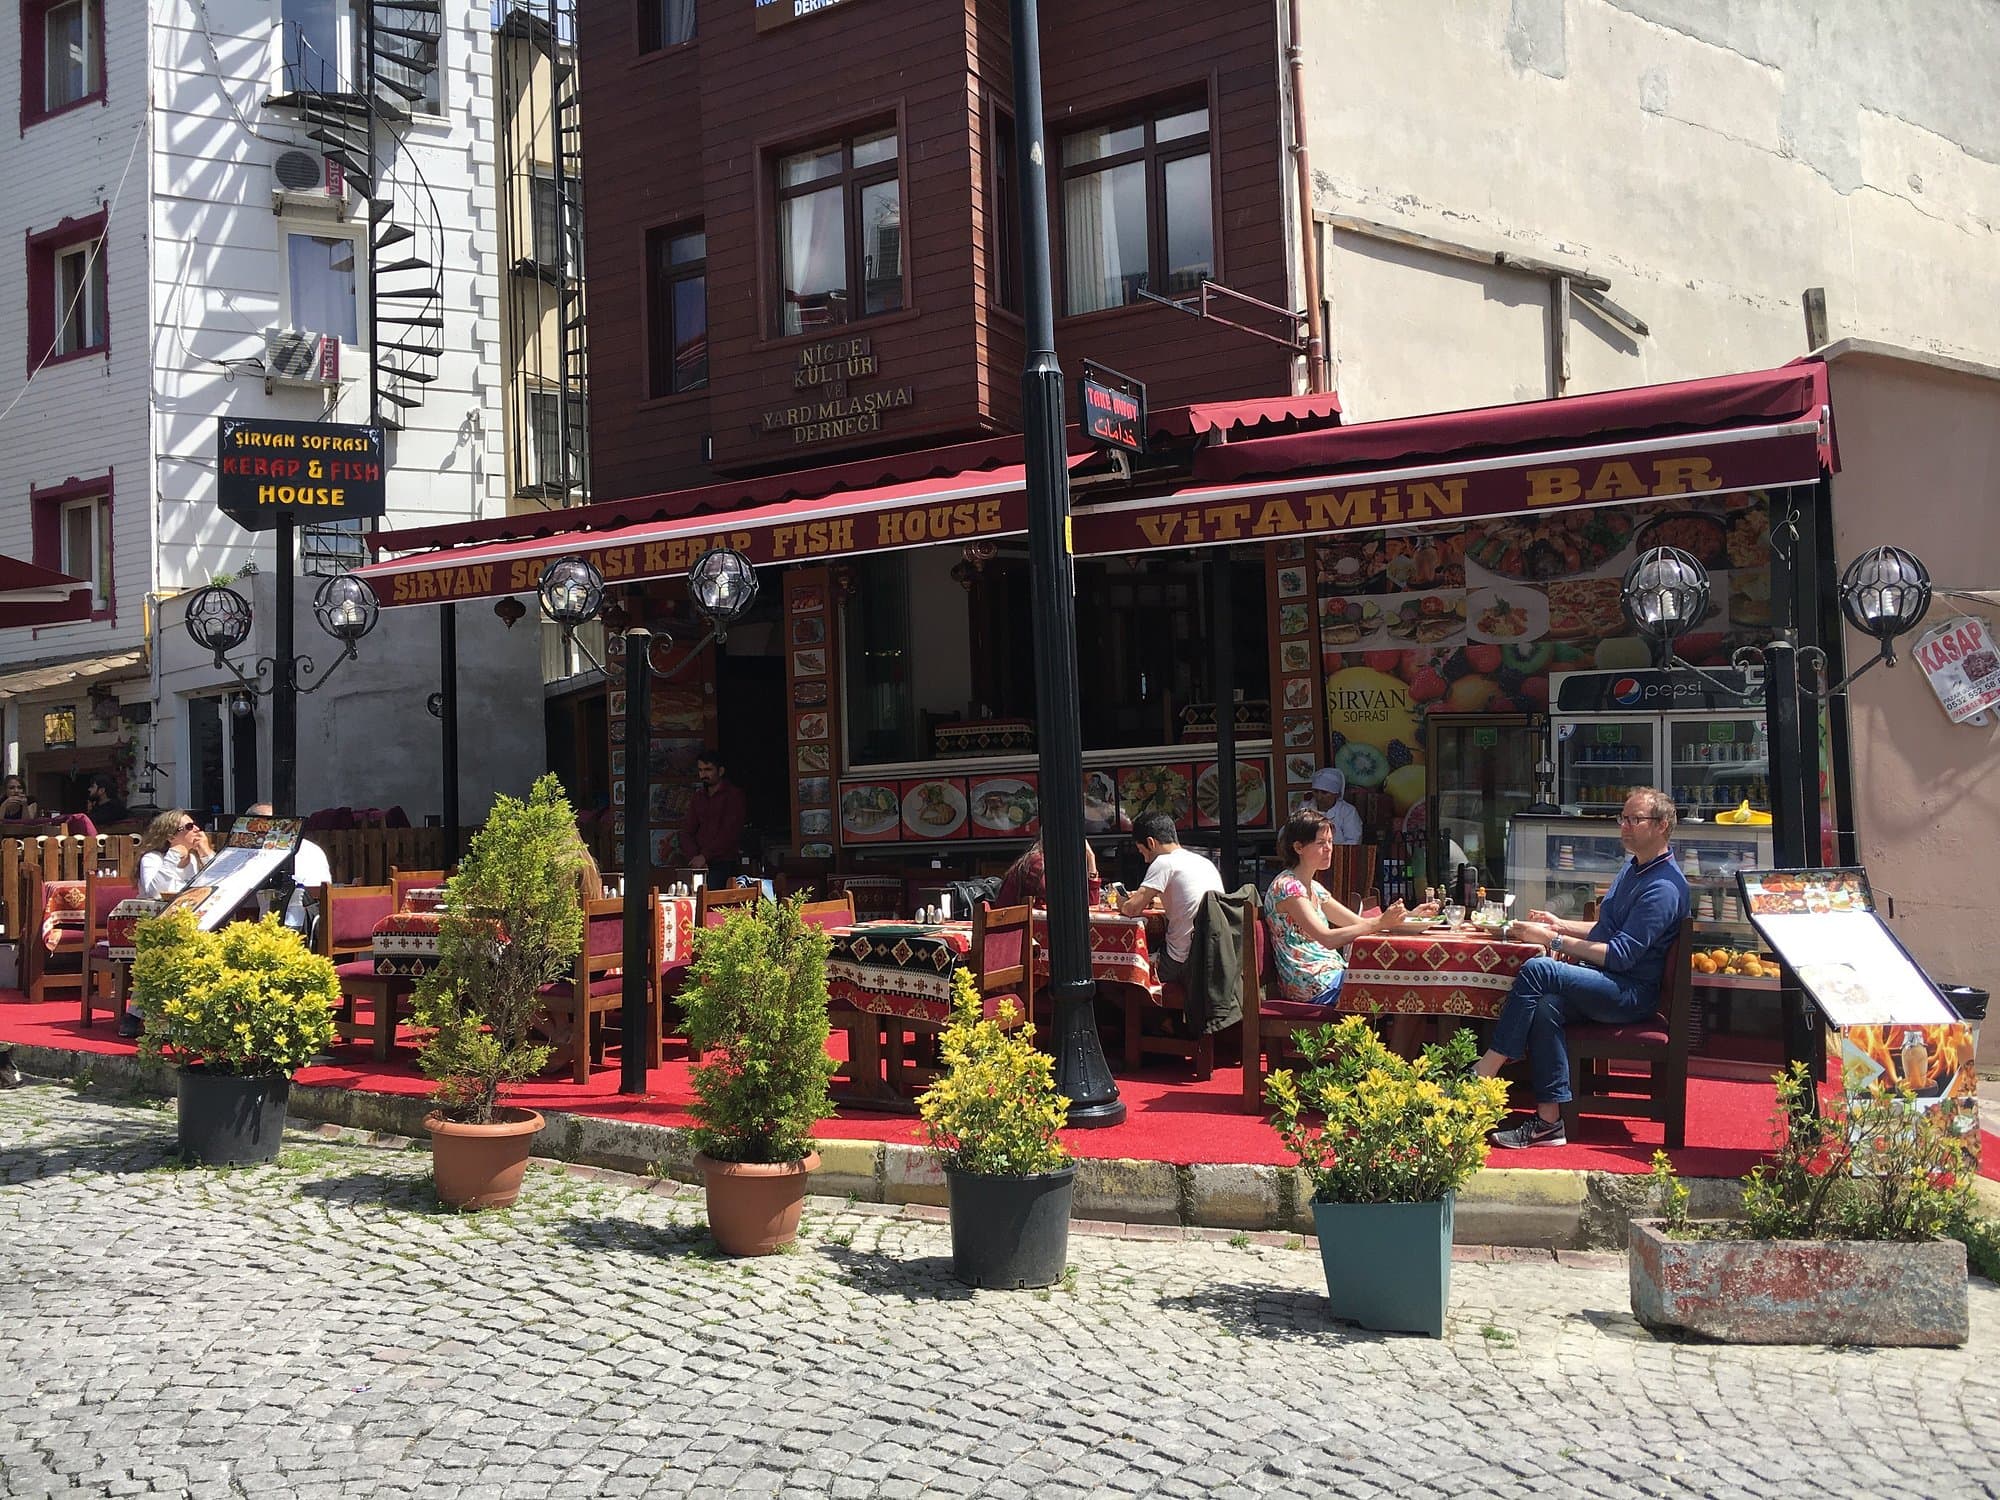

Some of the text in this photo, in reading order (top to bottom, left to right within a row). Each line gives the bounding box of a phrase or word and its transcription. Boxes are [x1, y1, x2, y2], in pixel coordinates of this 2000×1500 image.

[329, 160, 340, 194] VESTE
[324, 340, 334, 377] VESTEL
[1088, 387, 1137, 423] TAKE AWAY
[302, 435, 368, 452] SOFRASI
[223, 456, 379, 482] KEBAP & FISH
[1525, 456, 1724, 506] BAR
[258, 485, 345, 506] HOUSE
[511, 547, 636, 590] SOASI
[773, 518, 855, 558] FISH
[877, 499, 1002, 546] HOUSE
[1917, 621, 1983, 675] KASAP
[1644, 681, 1703, 700] pepsi
[1343, 709, 1390, 723] SOFRASI
